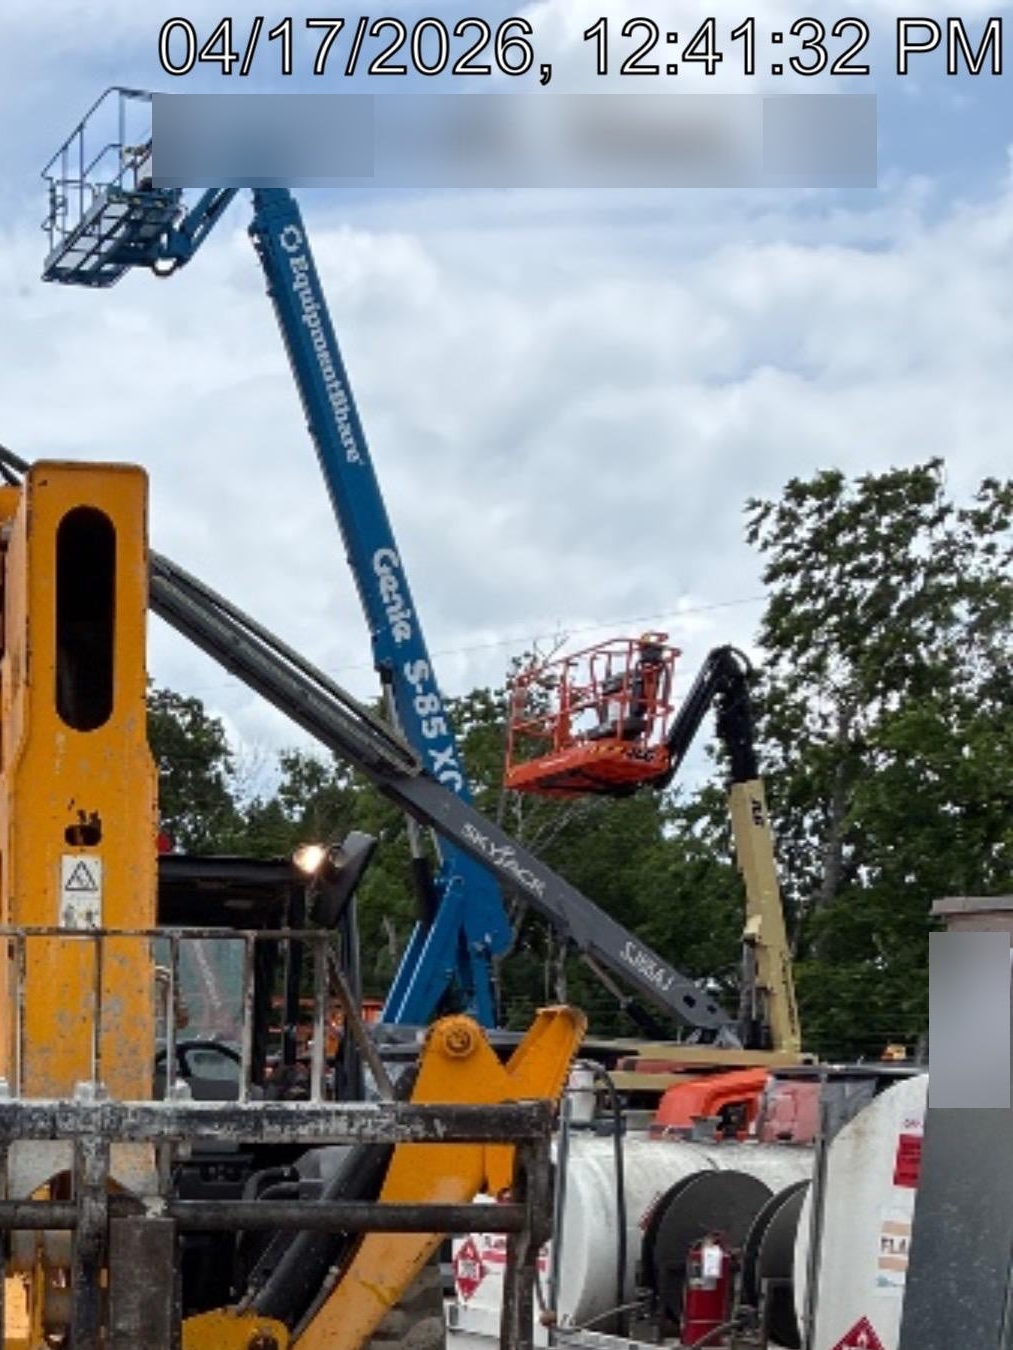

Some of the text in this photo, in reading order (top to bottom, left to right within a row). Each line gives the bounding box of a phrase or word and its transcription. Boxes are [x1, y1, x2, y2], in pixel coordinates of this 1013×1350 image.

[289, 255, 362, 464] EquipmentShare
[373, 548, 412, 643] Genie
[404, 659, 447, 739] S-85
